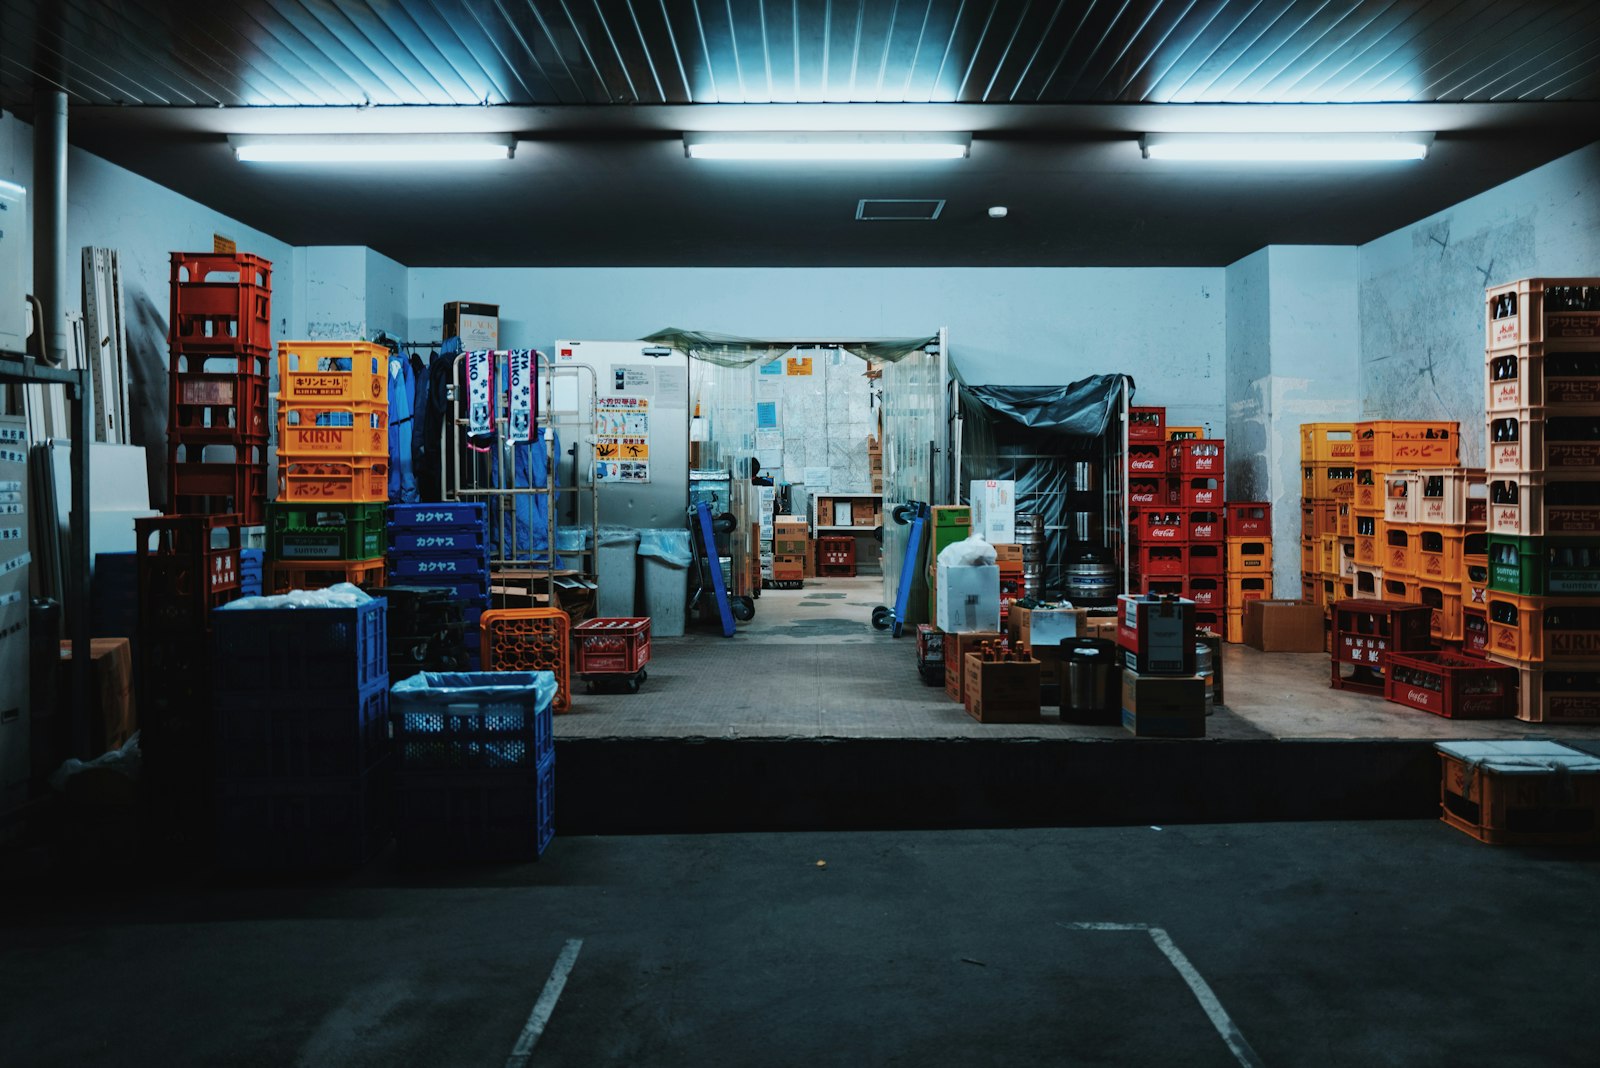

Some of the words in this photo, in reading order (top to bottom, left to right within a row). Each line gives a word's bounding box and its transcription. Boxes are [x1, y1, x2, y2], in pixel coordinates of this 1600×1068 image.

[1500, 323, 1515, 334] Asahi
[296, 378, 340, 386] キリンビール
[1549, 382, 1600, 392] アサヒビー
[1500, 385, 1516, 396] Asahi
[298, 431, 342, 443] KIRIN
[1396, 444, 1443, 458] ホッピー
[1502, 446, 1516, 457] Asahi
[1550, 447, 1600, 456] アサヒビー
[1132, 460, 1154, 469] Coca-Cola
[294, 481, 347, 496] ホッピー
[1132, 494, 1154, 502] Coca-Cola
[416, 512, 454, 522] カクヤス
[1501, 510, 1516, 519] Asahi
[1550, 511, 1600, 520] アサヒビー
[1152, 528, 1175, 537] Coca-Cola
[416, 537, 455, 547] カクヤス
[418, 562, 456, 572] カクヤス
[1496, 568, 1519, 576] SUNTORY
[1552, 634, 1600, 650] KIRIN
[1408, 690, 1428, 704] Coca-Cola
